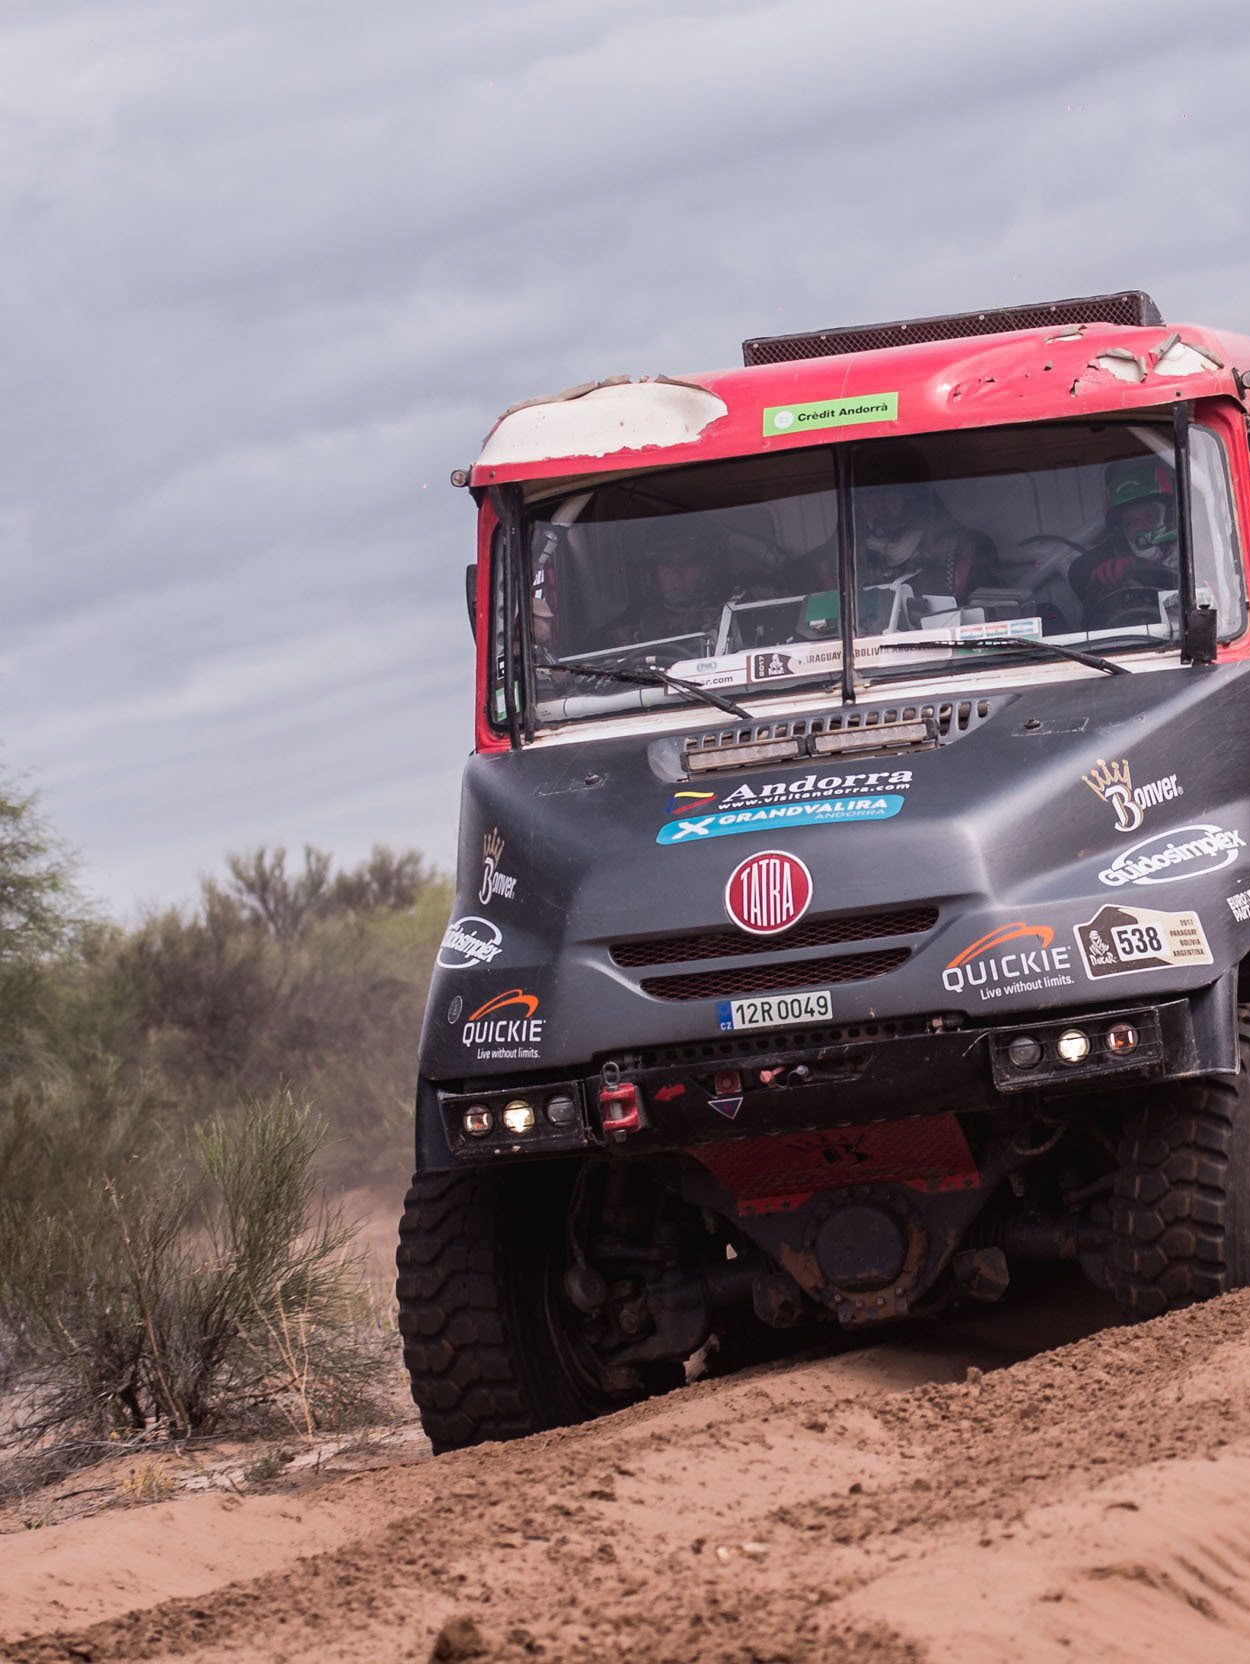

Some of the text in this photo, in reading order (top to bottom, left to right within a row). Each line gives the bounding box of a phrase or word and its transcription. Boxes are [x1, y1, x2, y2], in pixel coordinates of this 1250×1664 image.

[798, 403, 888, 422] Crèdit Andorrà
[799, 650, 842, 665] RAGUAY
[717, 782, 910, 810] www.visitandorra.com
[722, 770, 913, 803] Andorra
[718, 798, 889, 826] GRANDVALIRA
[814, 808, 886, 820] ANDORRA
[1104, 773, 1180, 832] Bonver
[1098, 829, 1247, 887] Guidosimplex
[478, 856, 517, 905] Bonver
[740, 858, 795, 927] TATRA
[1226, 891, 1249, 910] EURO
[1116, 926, 1163, 956] 538
[1170, 929, 1198, 937] PARAGUAY
[1179, 938, 1201, 947] BOLIVIA
[1173, 948, 1205, 958] ARGENTINA
[942, 946, 1072, 993] QUICKIE
[980, 974, 1075, 1001] Live without limits.
[736, 995, 829, 1025] 12R 0049
[462, 1019, 543, 1047] QUICKIE
[720, 1022, 733, 1031] CZ
[477, 1047, 541, 1059] Live without limits.
